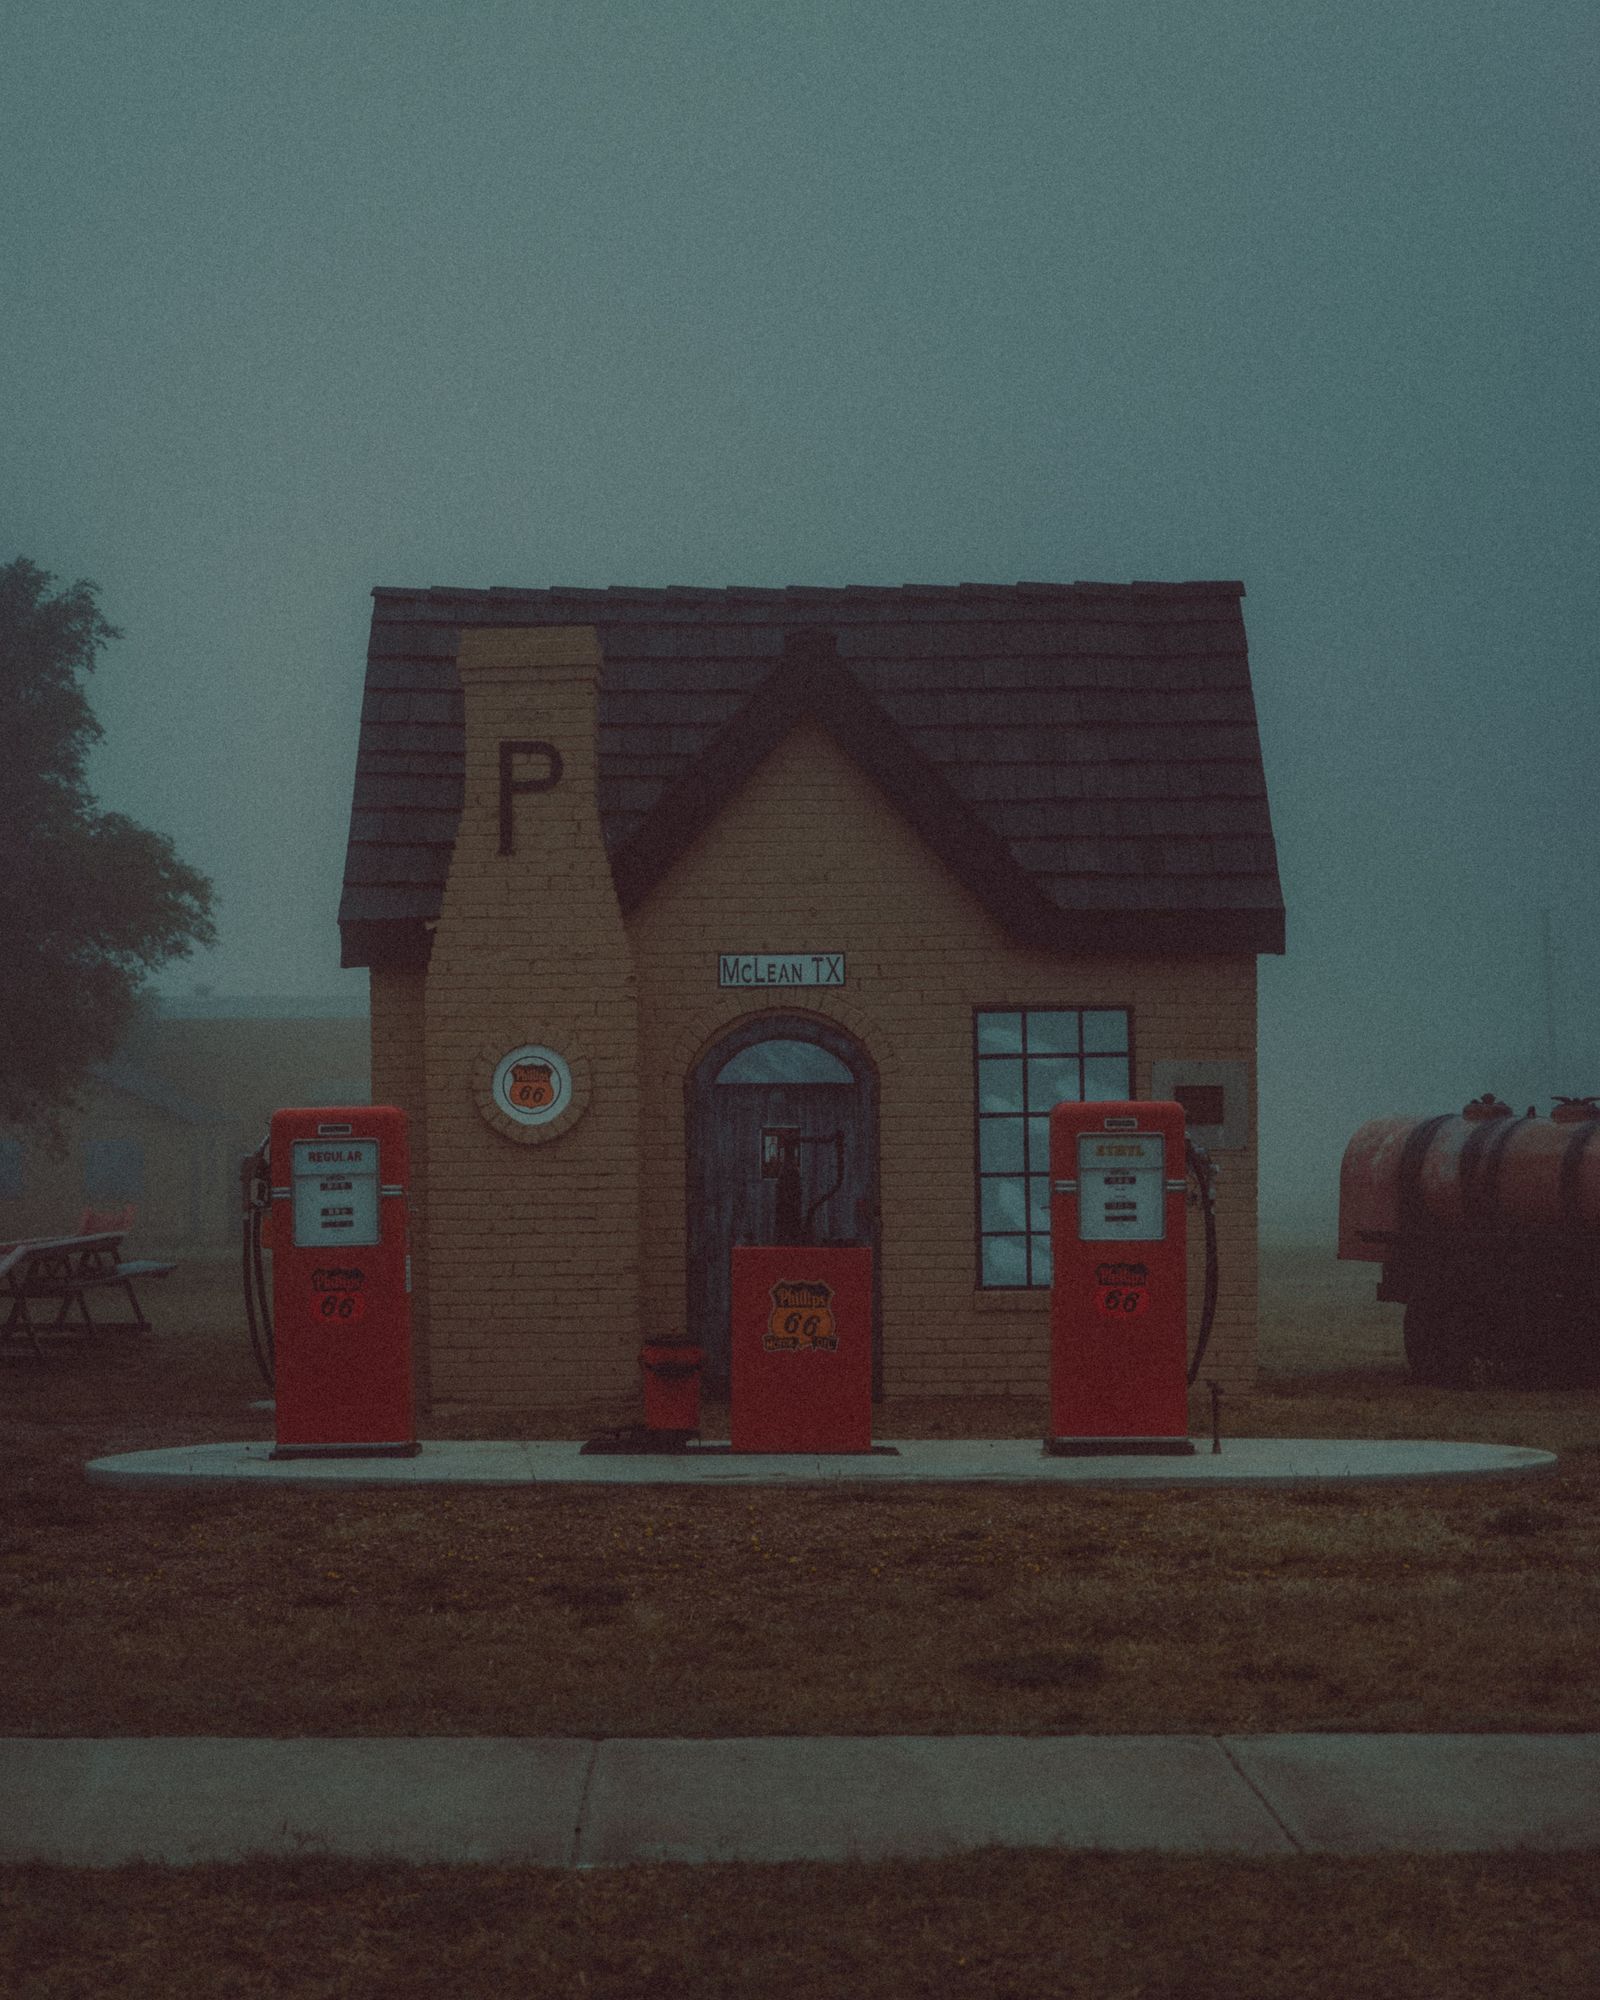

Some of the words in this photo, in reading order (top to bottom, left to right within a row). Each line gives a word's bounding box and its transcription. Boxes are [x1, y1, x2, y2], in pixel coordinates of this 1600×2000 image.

[499, 741, 564, 857] P
[811, 956, 842, 983] TX
[519, 1085, 547, 1104] 66
[308, 1151, 363, 1163] REGULAR
[321, 1295, 356, 1319] 66
[776, 1288, 828, 1309] Phillips
[1105, 1290, 1141, 1313] 66
[784, 1312, 821, 1336] 66
